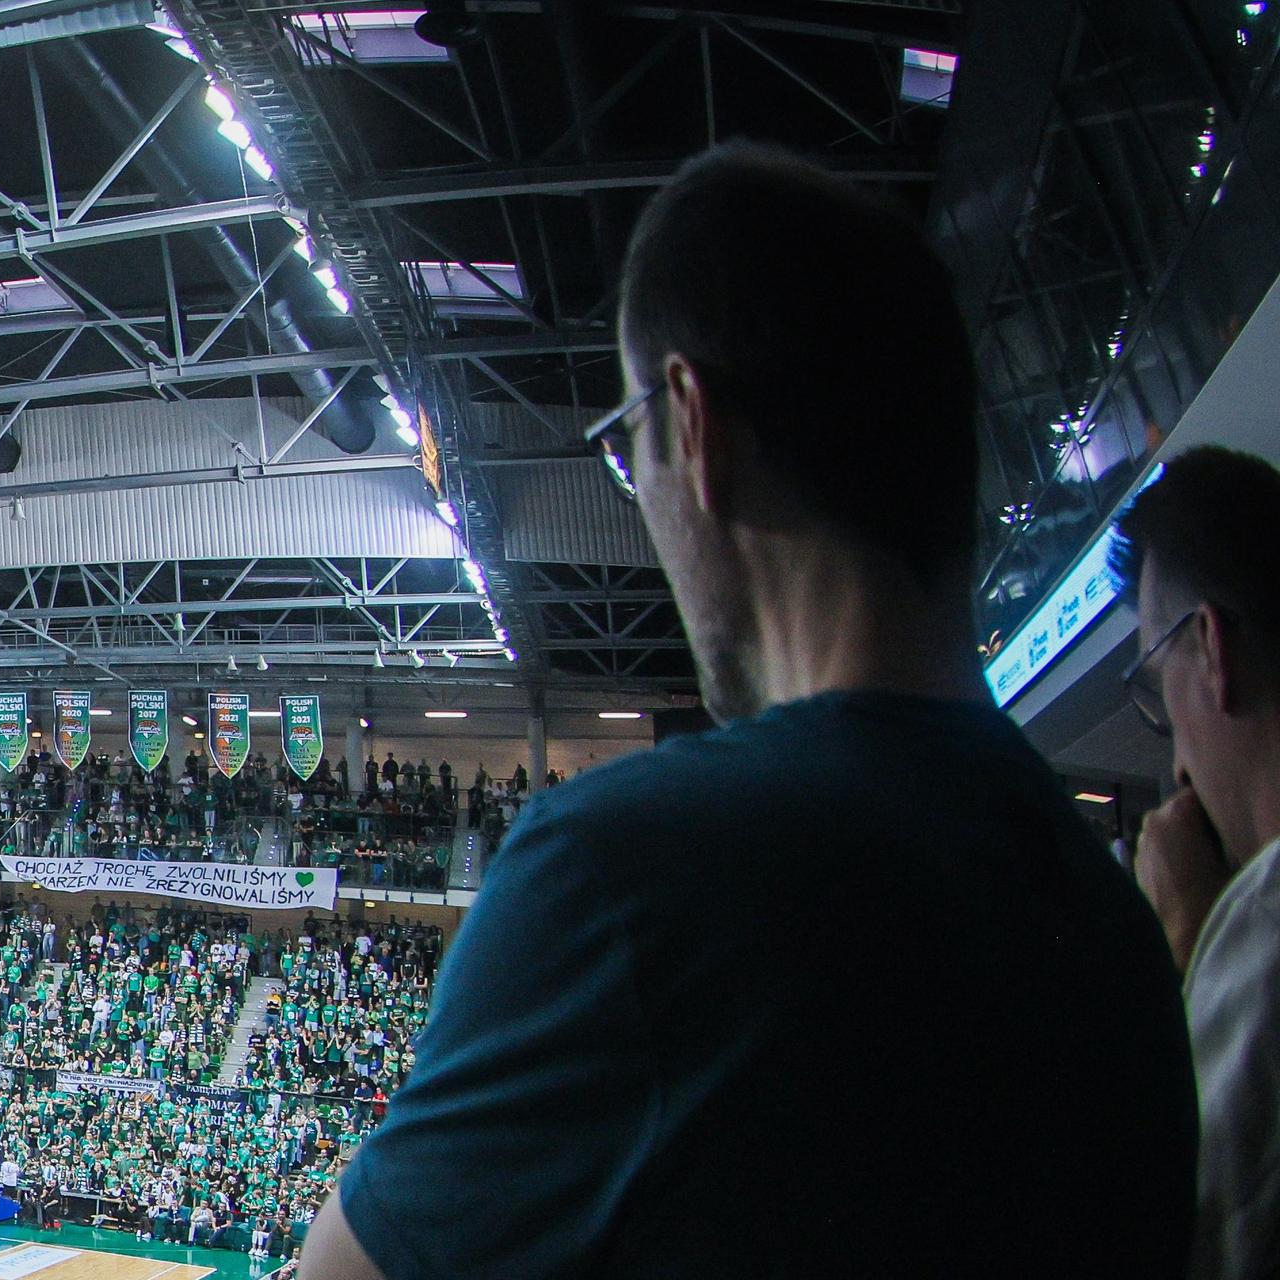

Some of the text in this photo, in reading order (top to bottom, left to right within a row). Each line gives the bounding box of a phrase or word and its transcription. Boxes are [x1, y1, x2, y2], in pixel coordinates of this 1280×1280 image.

[131, 694, 164, 702] PUCHAR
[56, 699, 88, 707] POLSKI
[131, 701, 165, 709] POLSKI
[62, 709, 82, 717] 2020
[292, 705, 308, 713] CUP
[0, 713, 18, 721] 2015
[219, 714, 238, 722] 2021
[16, 860, 287, 887] CHOCIAŻ TROCHĘ ZWOLNILIŚMY
[107, 876, 136, 888] NIE
[186, 1085, 232, 1096] PAMIĘTAMY
